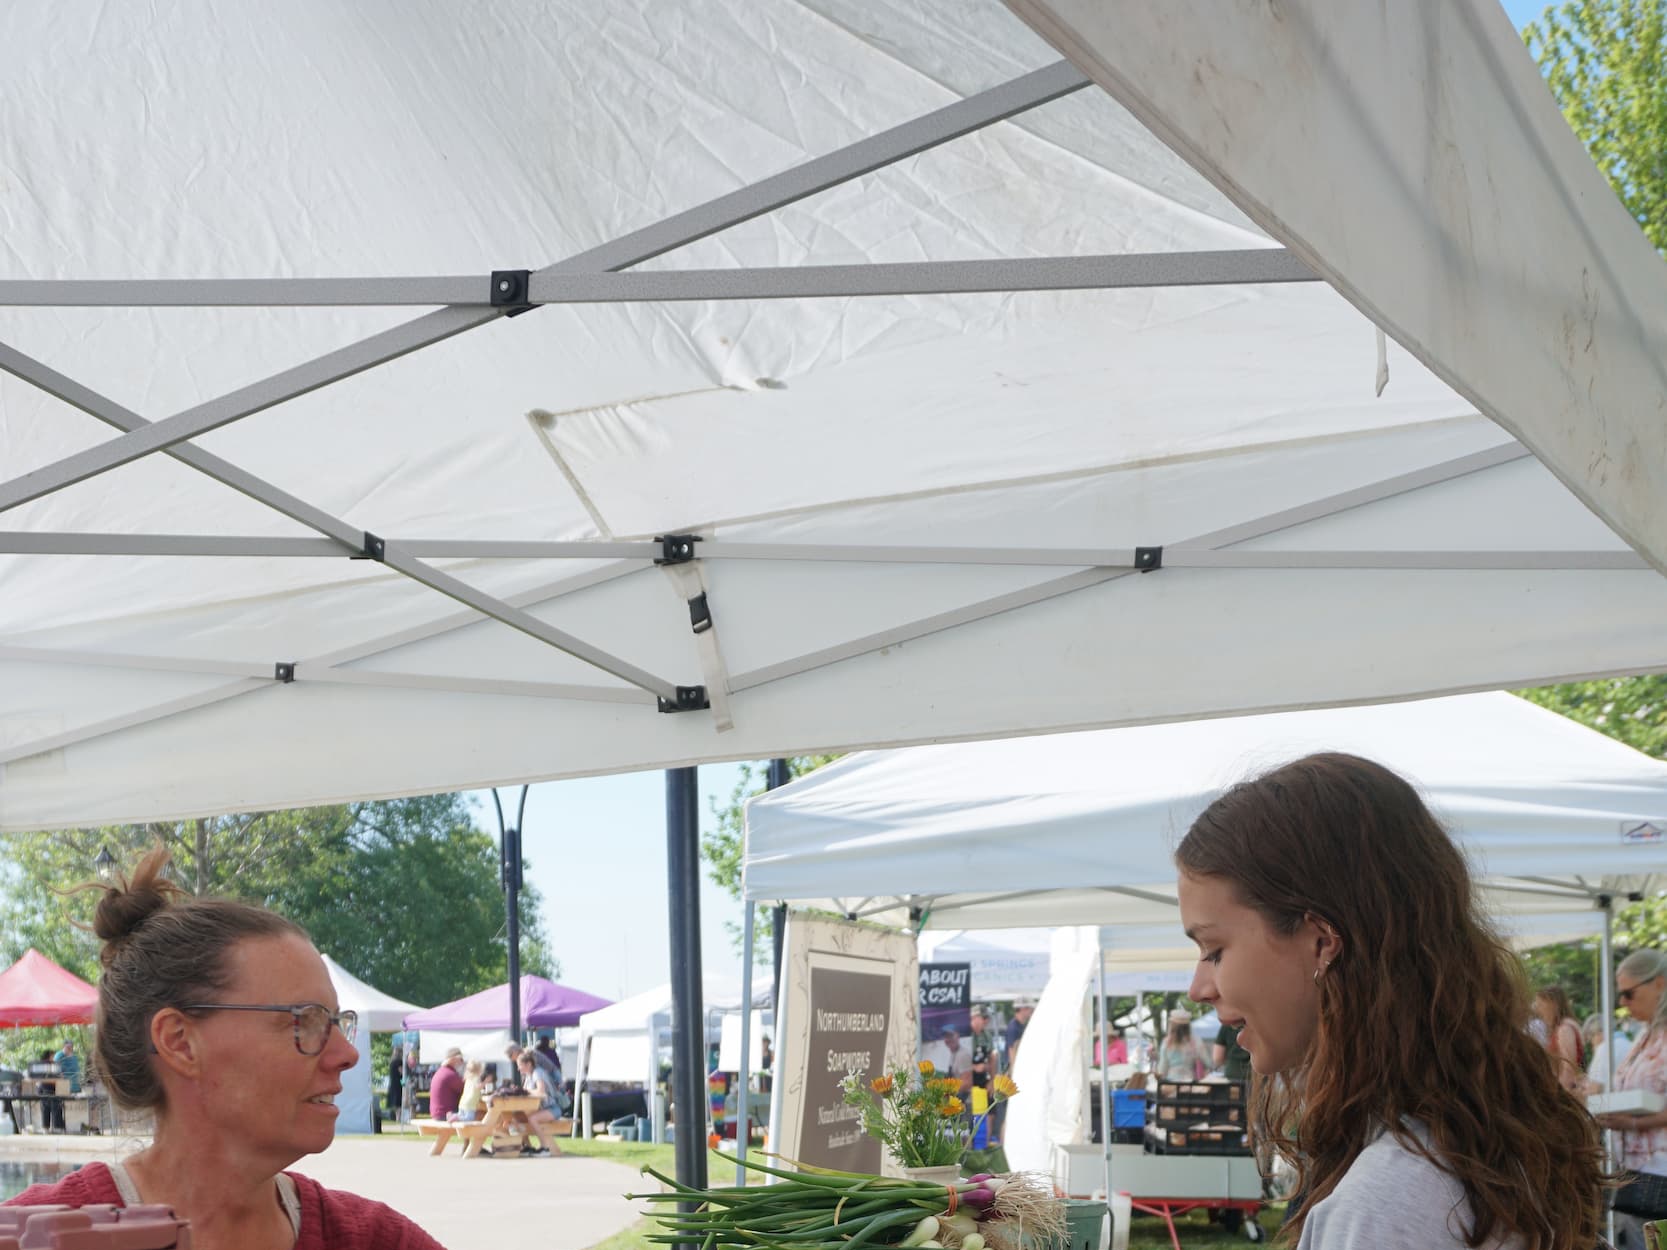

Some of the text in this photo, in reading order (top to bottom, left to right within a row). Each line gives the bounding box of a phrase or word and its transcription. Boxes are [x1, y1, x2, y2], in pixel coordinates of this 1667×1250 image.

[919, 969, 968, 985] ABOUT
[928, 985, 963, 1005] CSA!
[817, 1007, 884, 1032] NORTHUMBERLAND
